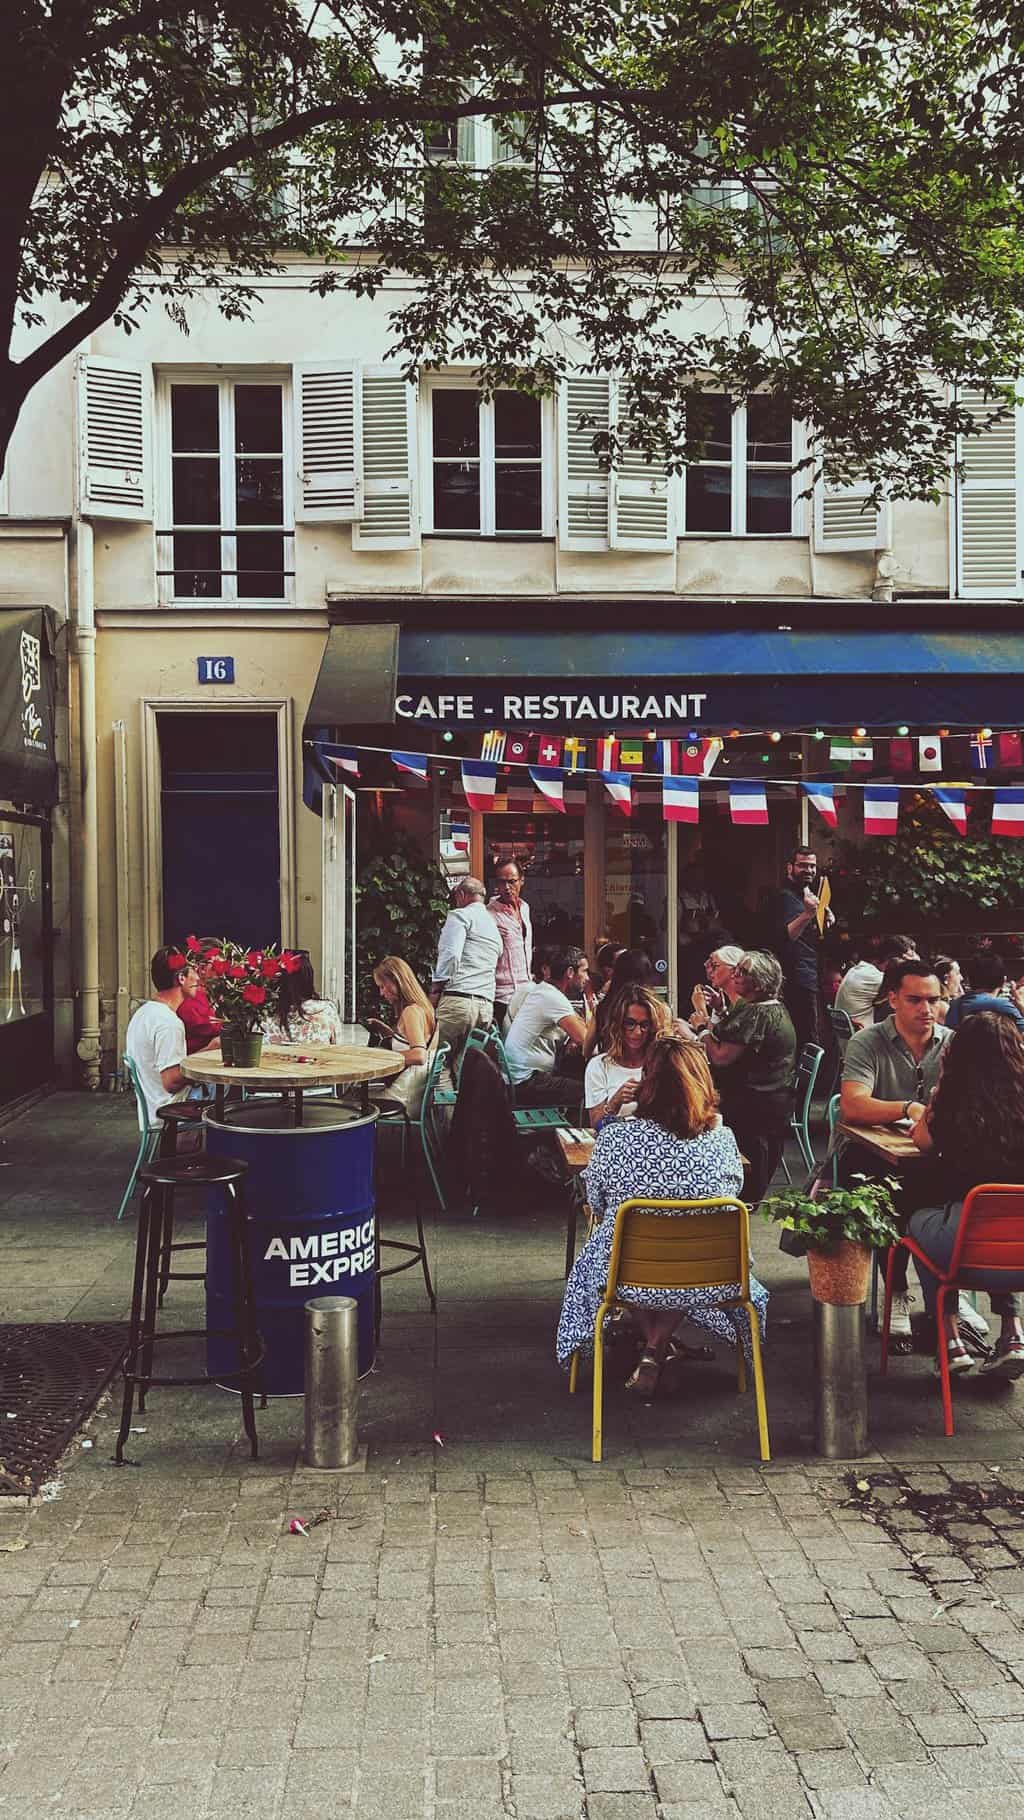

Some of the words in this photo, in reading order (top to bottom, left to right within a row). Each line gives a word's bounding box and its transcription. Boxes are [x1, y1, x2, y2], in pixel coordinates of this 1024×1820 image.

[206, 660, 226, 679] 16
[395, 695, 474, 719] CAFE
[503, 694, 707, 719] RESTAURANT
[290, 1247, 375, 1287] EXPRE
